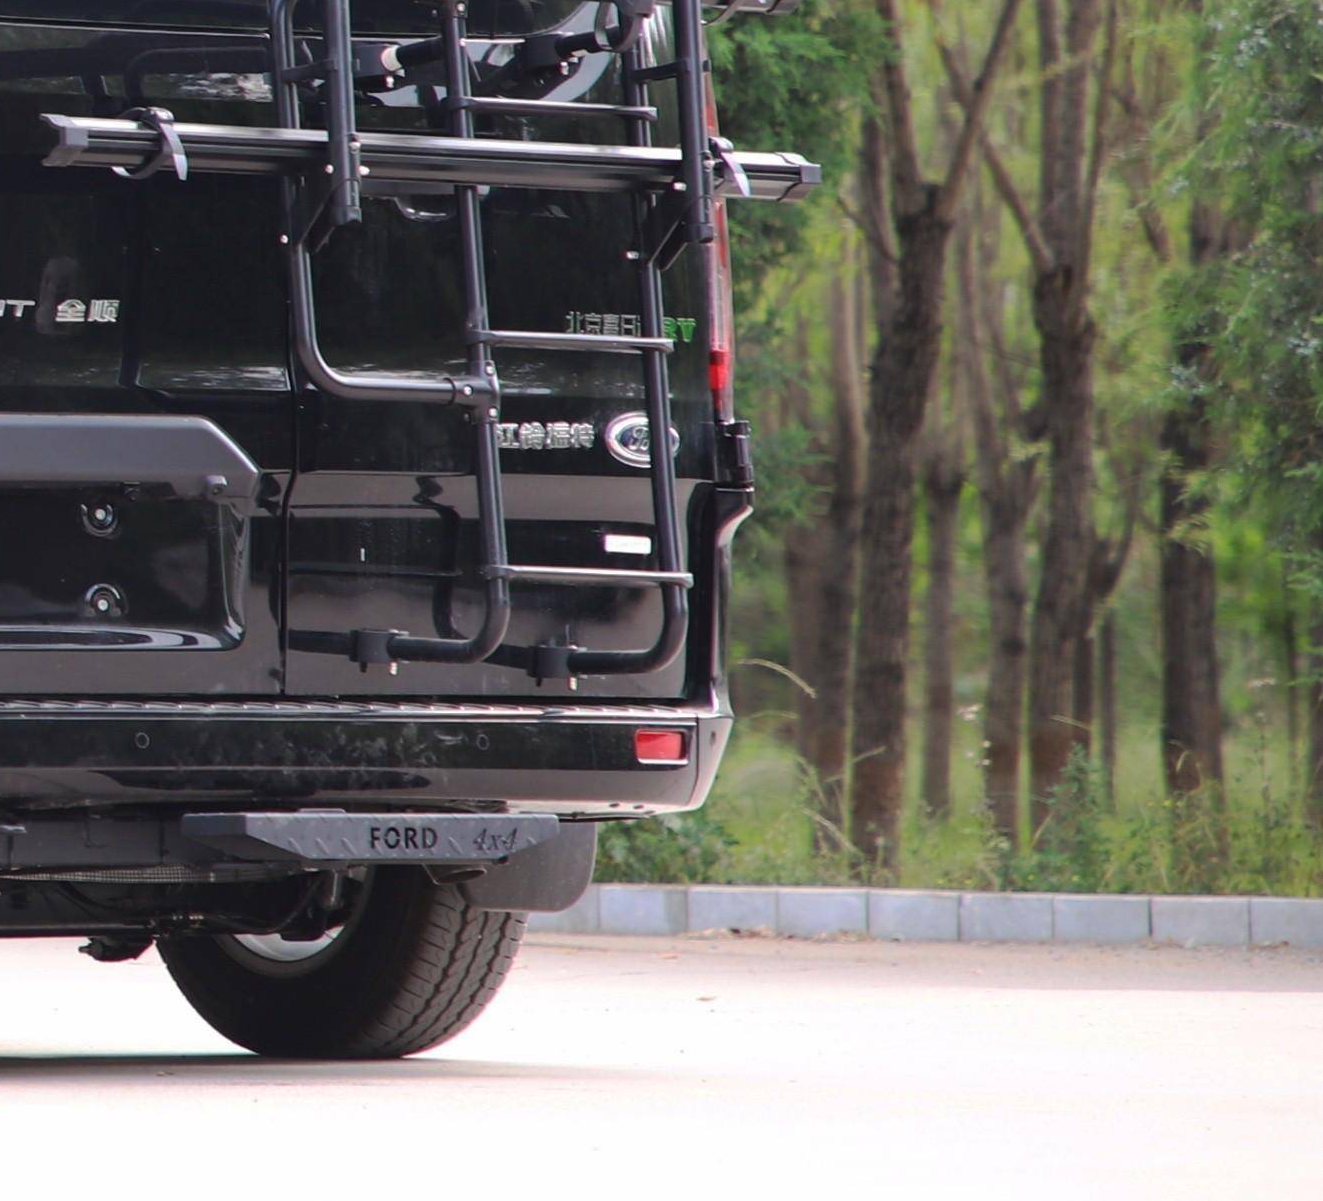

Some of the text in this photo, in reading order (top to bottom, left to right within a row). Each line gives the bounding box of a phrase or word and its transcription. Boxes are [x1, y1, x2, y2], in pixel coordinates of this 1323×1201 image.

[55, 298, 121, 323] 全顺
[370, 826, 519, 851] FORD 4x4
